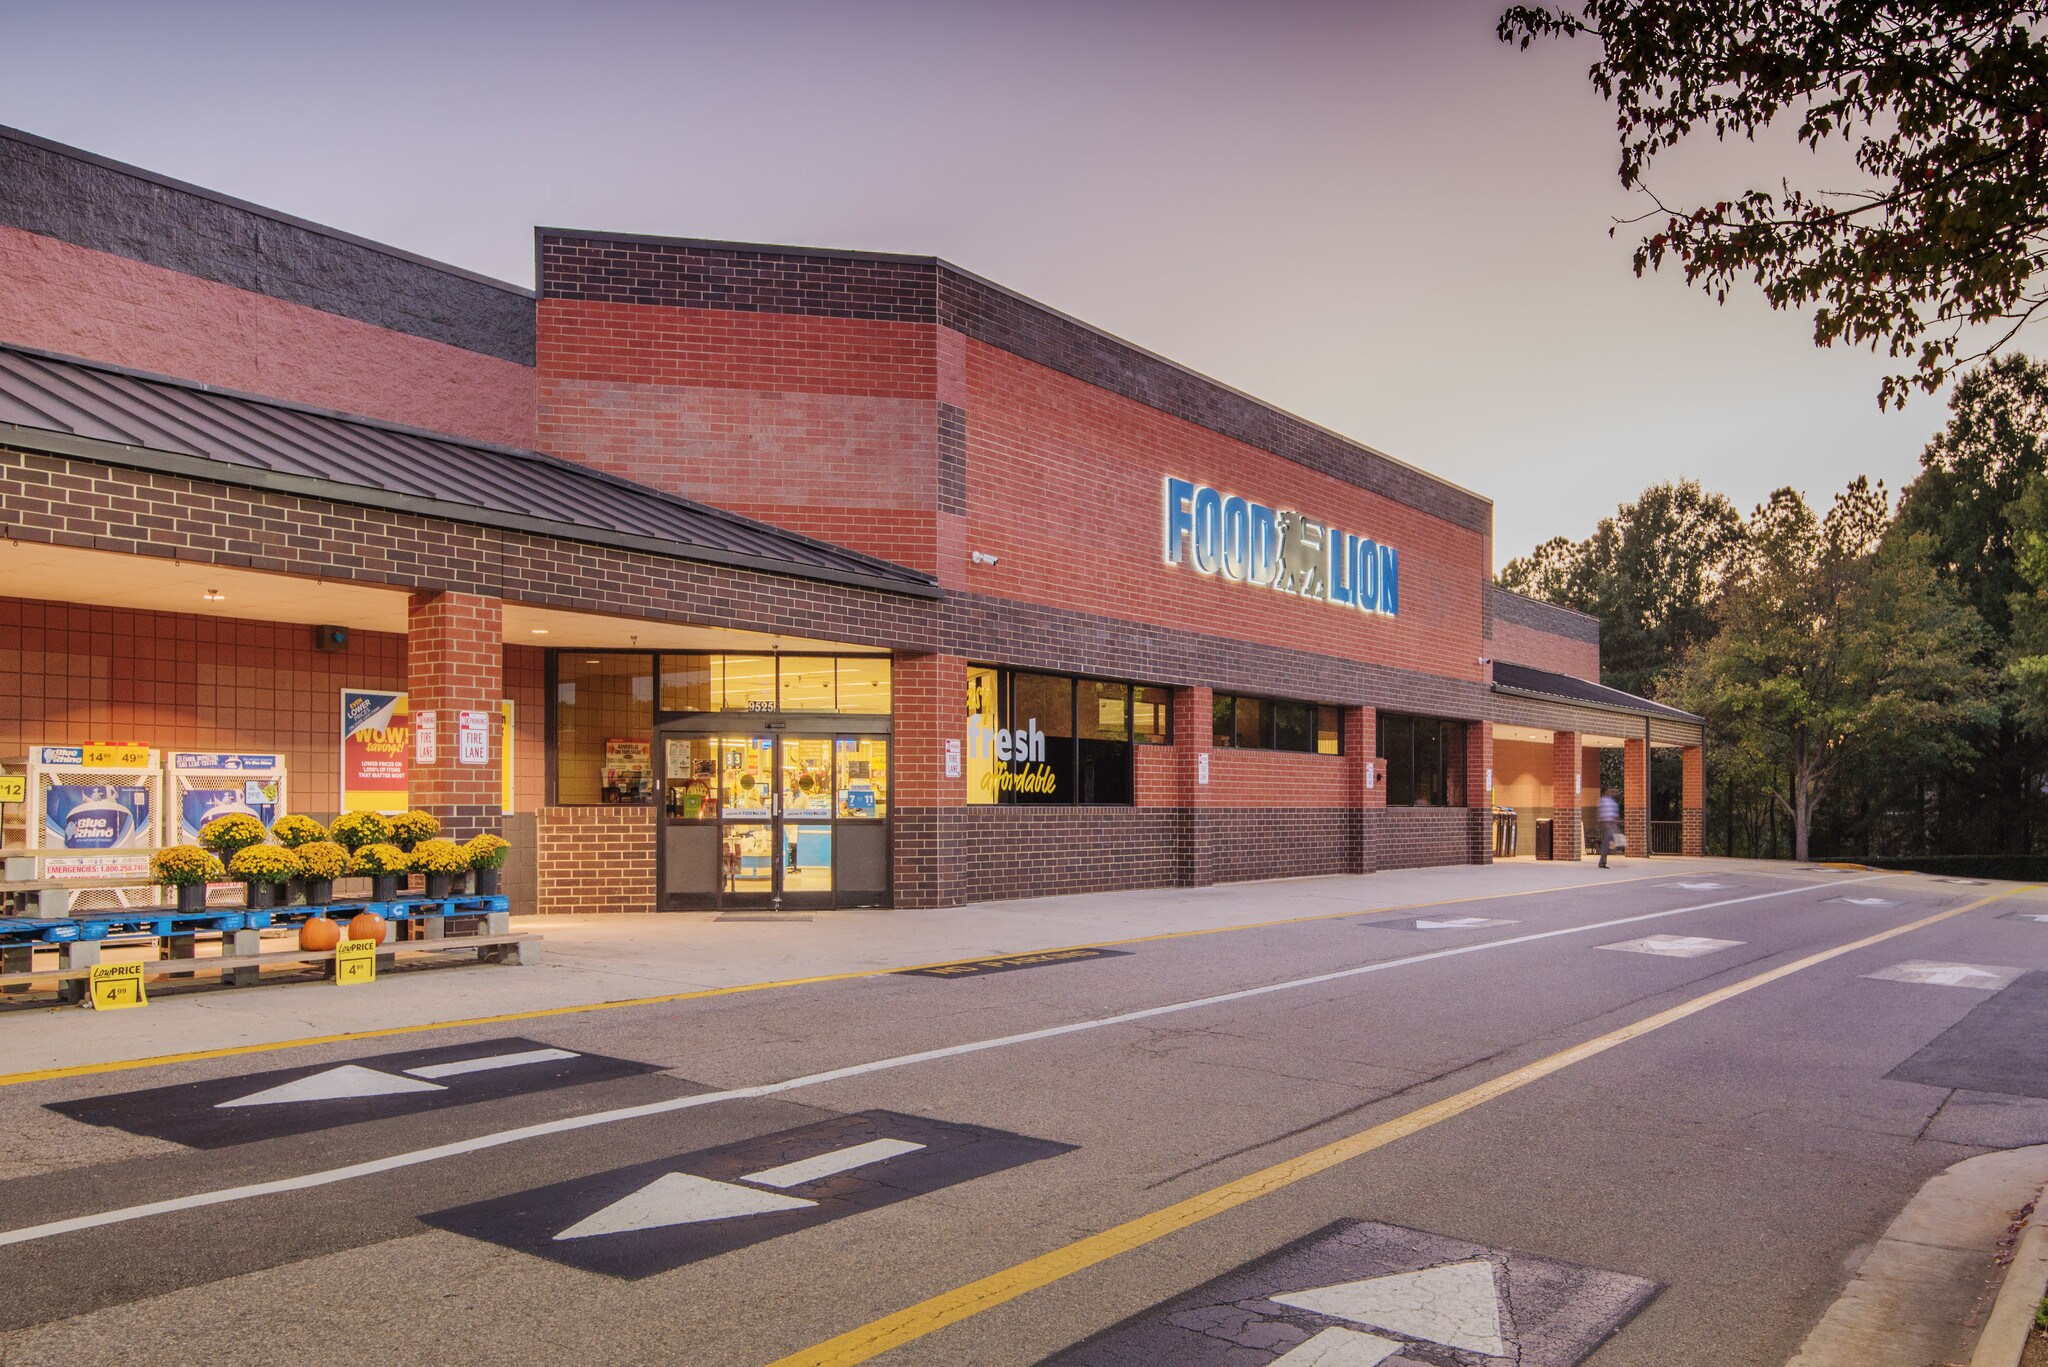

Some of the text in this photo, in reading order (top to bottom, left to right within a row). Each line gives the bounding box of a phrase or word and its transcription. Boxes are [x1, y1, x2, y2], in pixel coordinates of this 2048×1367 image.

[1165, 477, 1399, 616] FOOD LION
[347, 699, 371, 719] LOWER
[349, 697, 362, 710] EVEN
[748, 701, 774, 712] 9525
[967, 686, 992, 725] asy
[354, 707, 370, 721] PRICES
[356, 727, 408, 744] WOW!
[420, 732, 432, 743] FIRE
[466, 733, 482, 744] FIRE
[968, 714, 1046, 762] fresh
[366, 741, 404, 758] savings!
[420, 746, 433, 757] LANE
[466, 747, 483, 758] LANE
[735, 754, 740, 764] 3
[981, 761, 1056, 798] affordable
[850, 794, 855, 803] 7
[865, 794, 873, 804] 11
[77, 818, 106, 828] Blue
[75, 827, 113, 838] Rhino
